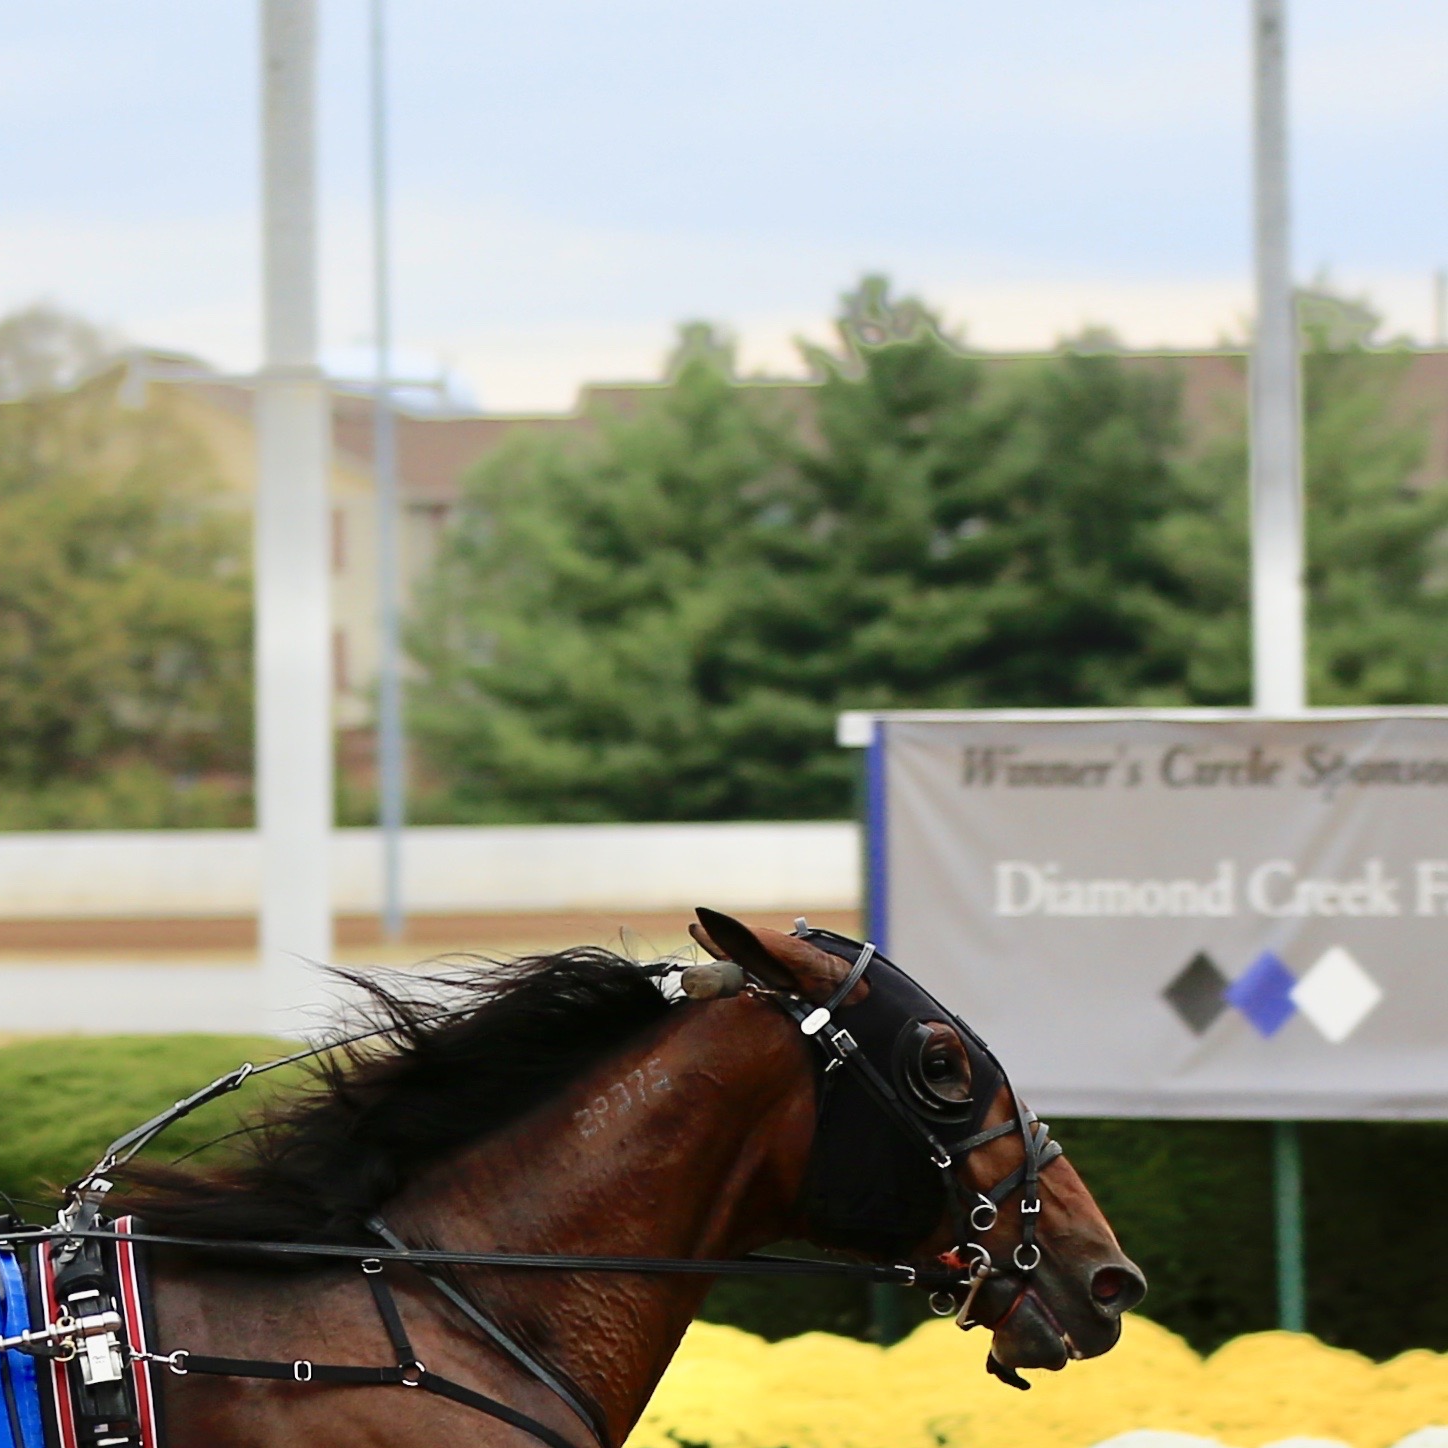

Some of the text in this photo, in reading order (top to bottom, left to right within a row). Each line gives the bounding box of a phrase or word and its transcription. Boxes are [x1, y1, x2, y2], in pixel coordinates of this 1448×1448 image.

[961, 744, 1142, 788] Winner's
[1159, 743, 1284, 788] Circle
[996, 859, 1235, 917] Diamond
[1247, 859, 1401, 917] Creek
